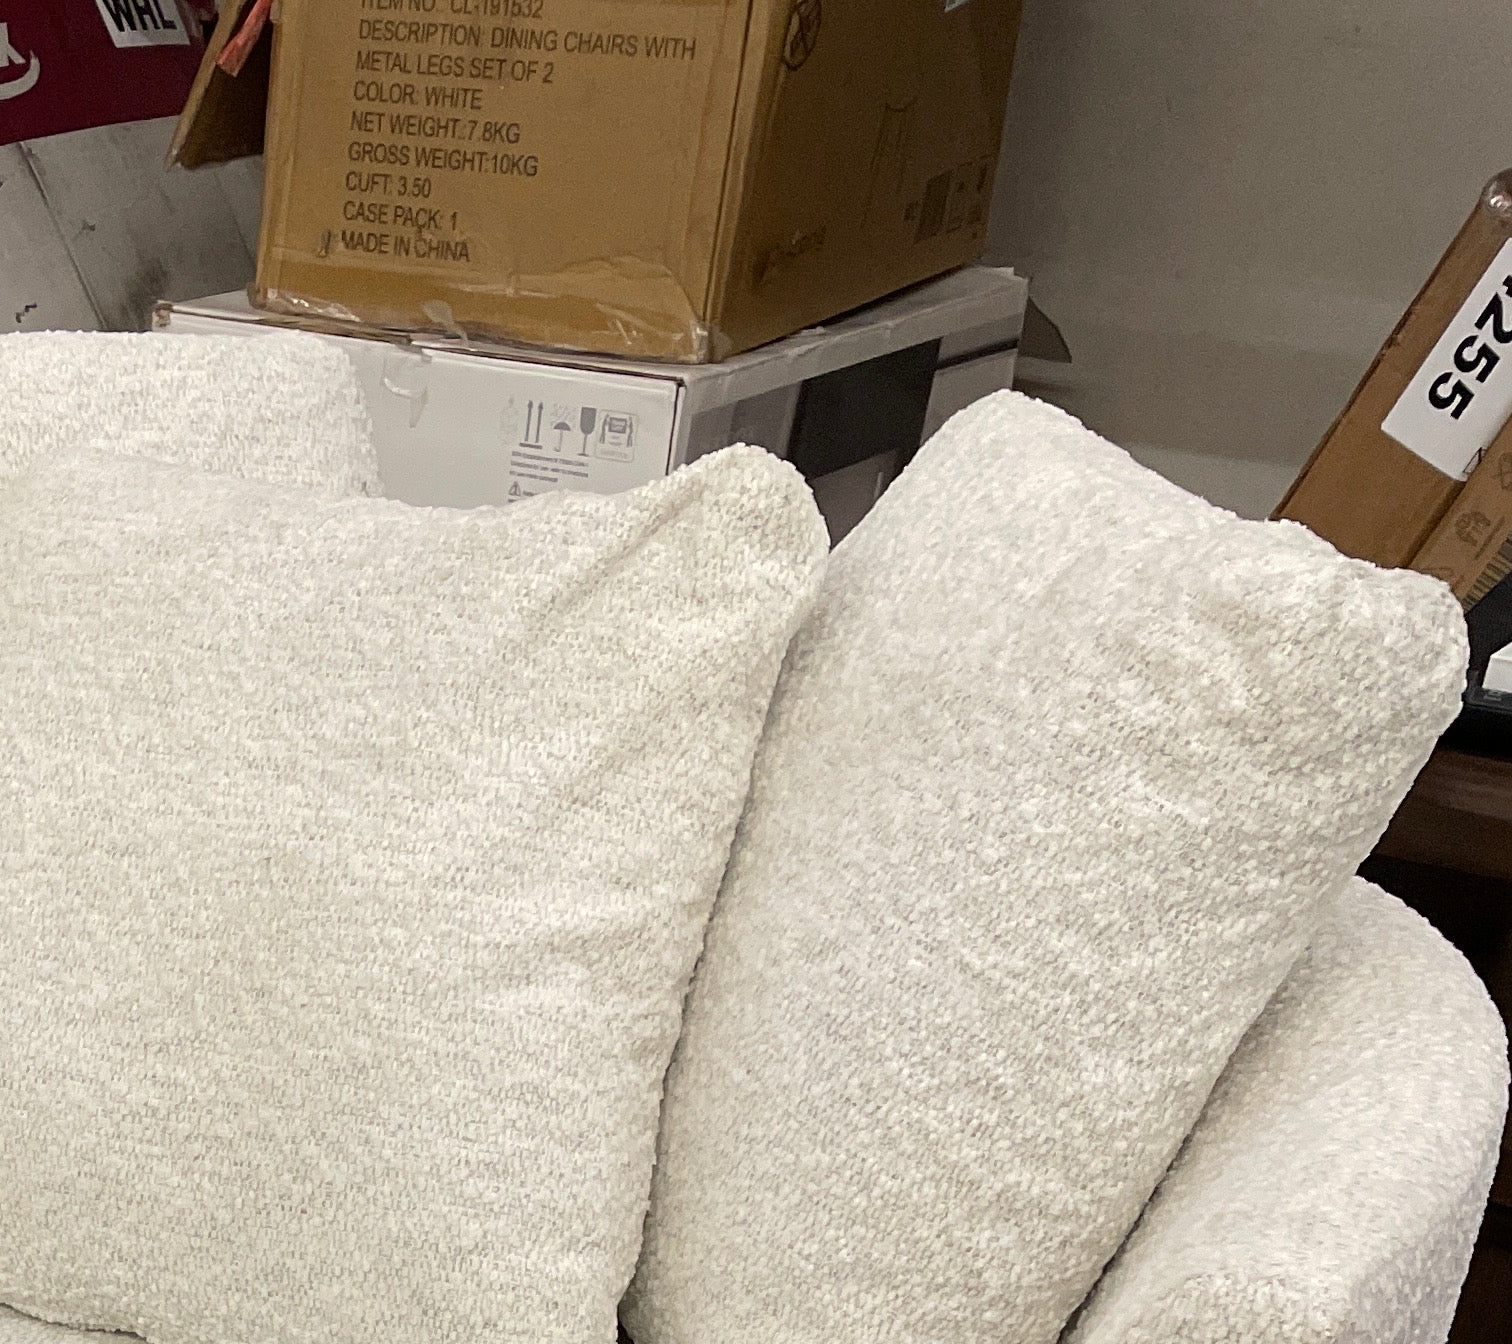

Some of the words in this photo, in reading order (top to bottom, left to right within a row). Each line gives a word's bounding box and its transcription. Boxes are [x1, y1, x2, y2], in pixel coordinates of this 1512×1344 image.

[490, 26, 558, 52] DINING
[564, 31, 639, 57] CHAIRS
[644, 35, 697, 60] WITH
[356, 50, 412, 74] METAL
[417, 53, 464, 78] LEGS
[469, 57, 507, 80] SET
[511, 60, 538, 82] OF
[542, 62, 554, 84] 2
[425, 86, 483, 110] WHITE
[351, 111, 385, 133] NET
[348, 141, 409, 166] GROSS
[398, 175, 432, 198] 3.50
[343, 201, 389, 224] CASE
[450, 211, 457, 230] 1
[341, 230, 389, 254] MADE
[394, 236, 410, 256] IN
[414, 238, 470, 262] CHINA
[1428, 275, 1512, 420] 255
